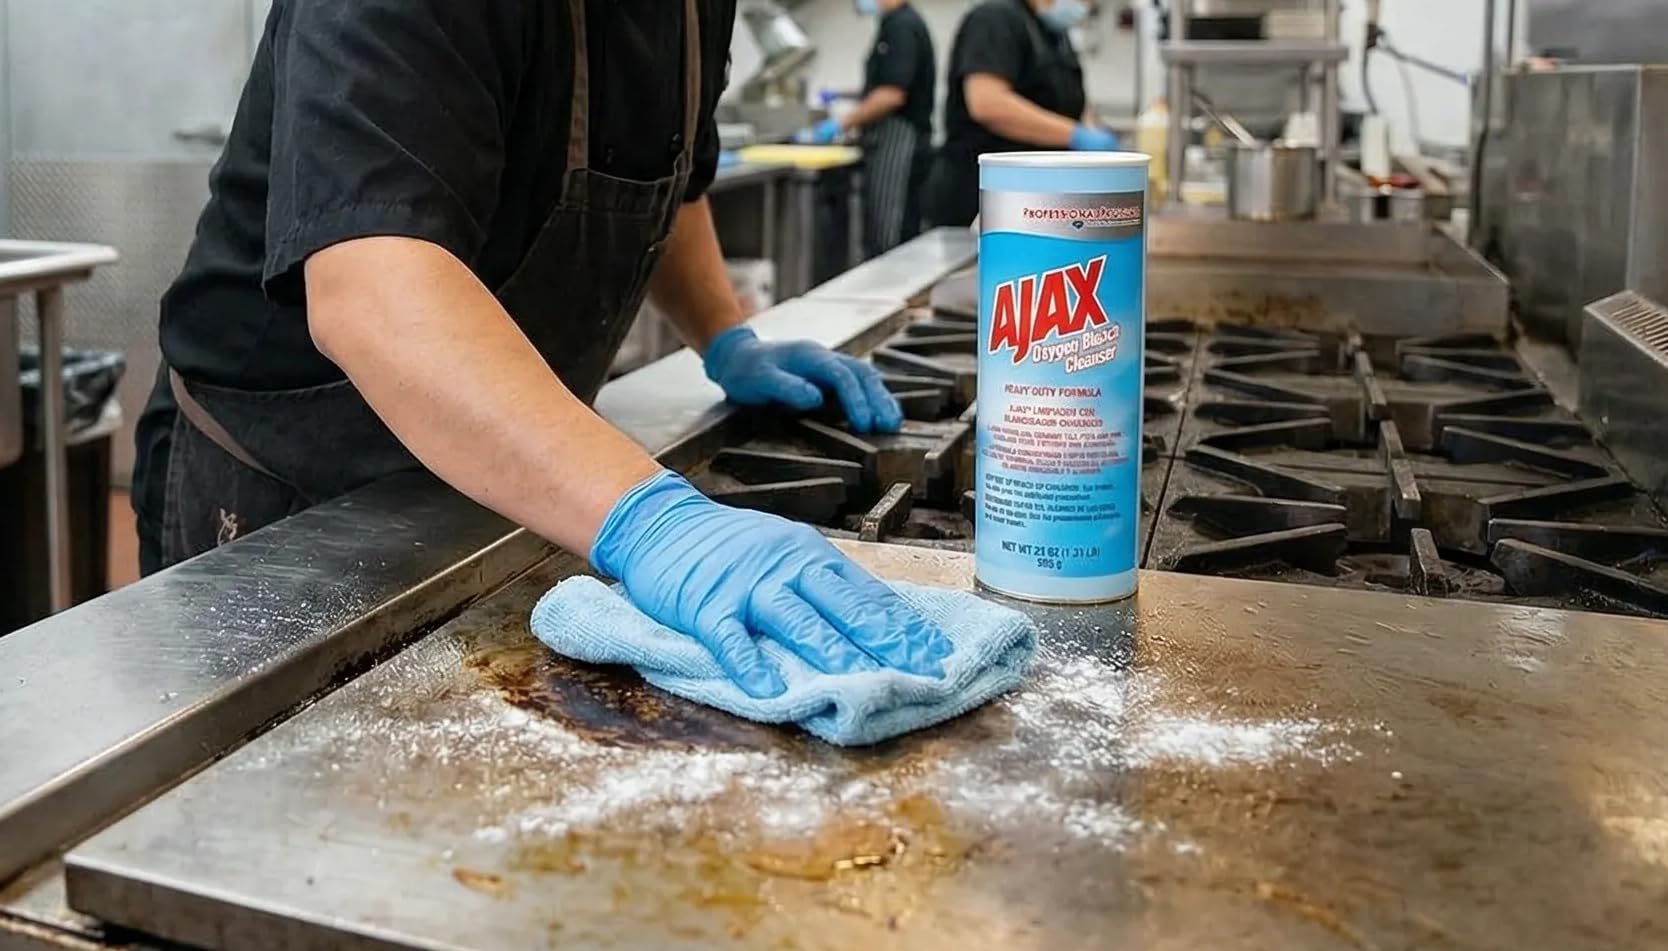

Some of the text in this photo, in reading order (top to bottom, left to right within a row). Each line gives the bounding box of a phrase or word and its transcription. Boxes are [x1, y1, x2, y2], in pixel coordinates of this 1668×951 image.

[988, 254, 1109, 365] AJAX
[1065, 347, 1117, 373] Cleanser
[1001, 540, 1017, 552] NET
